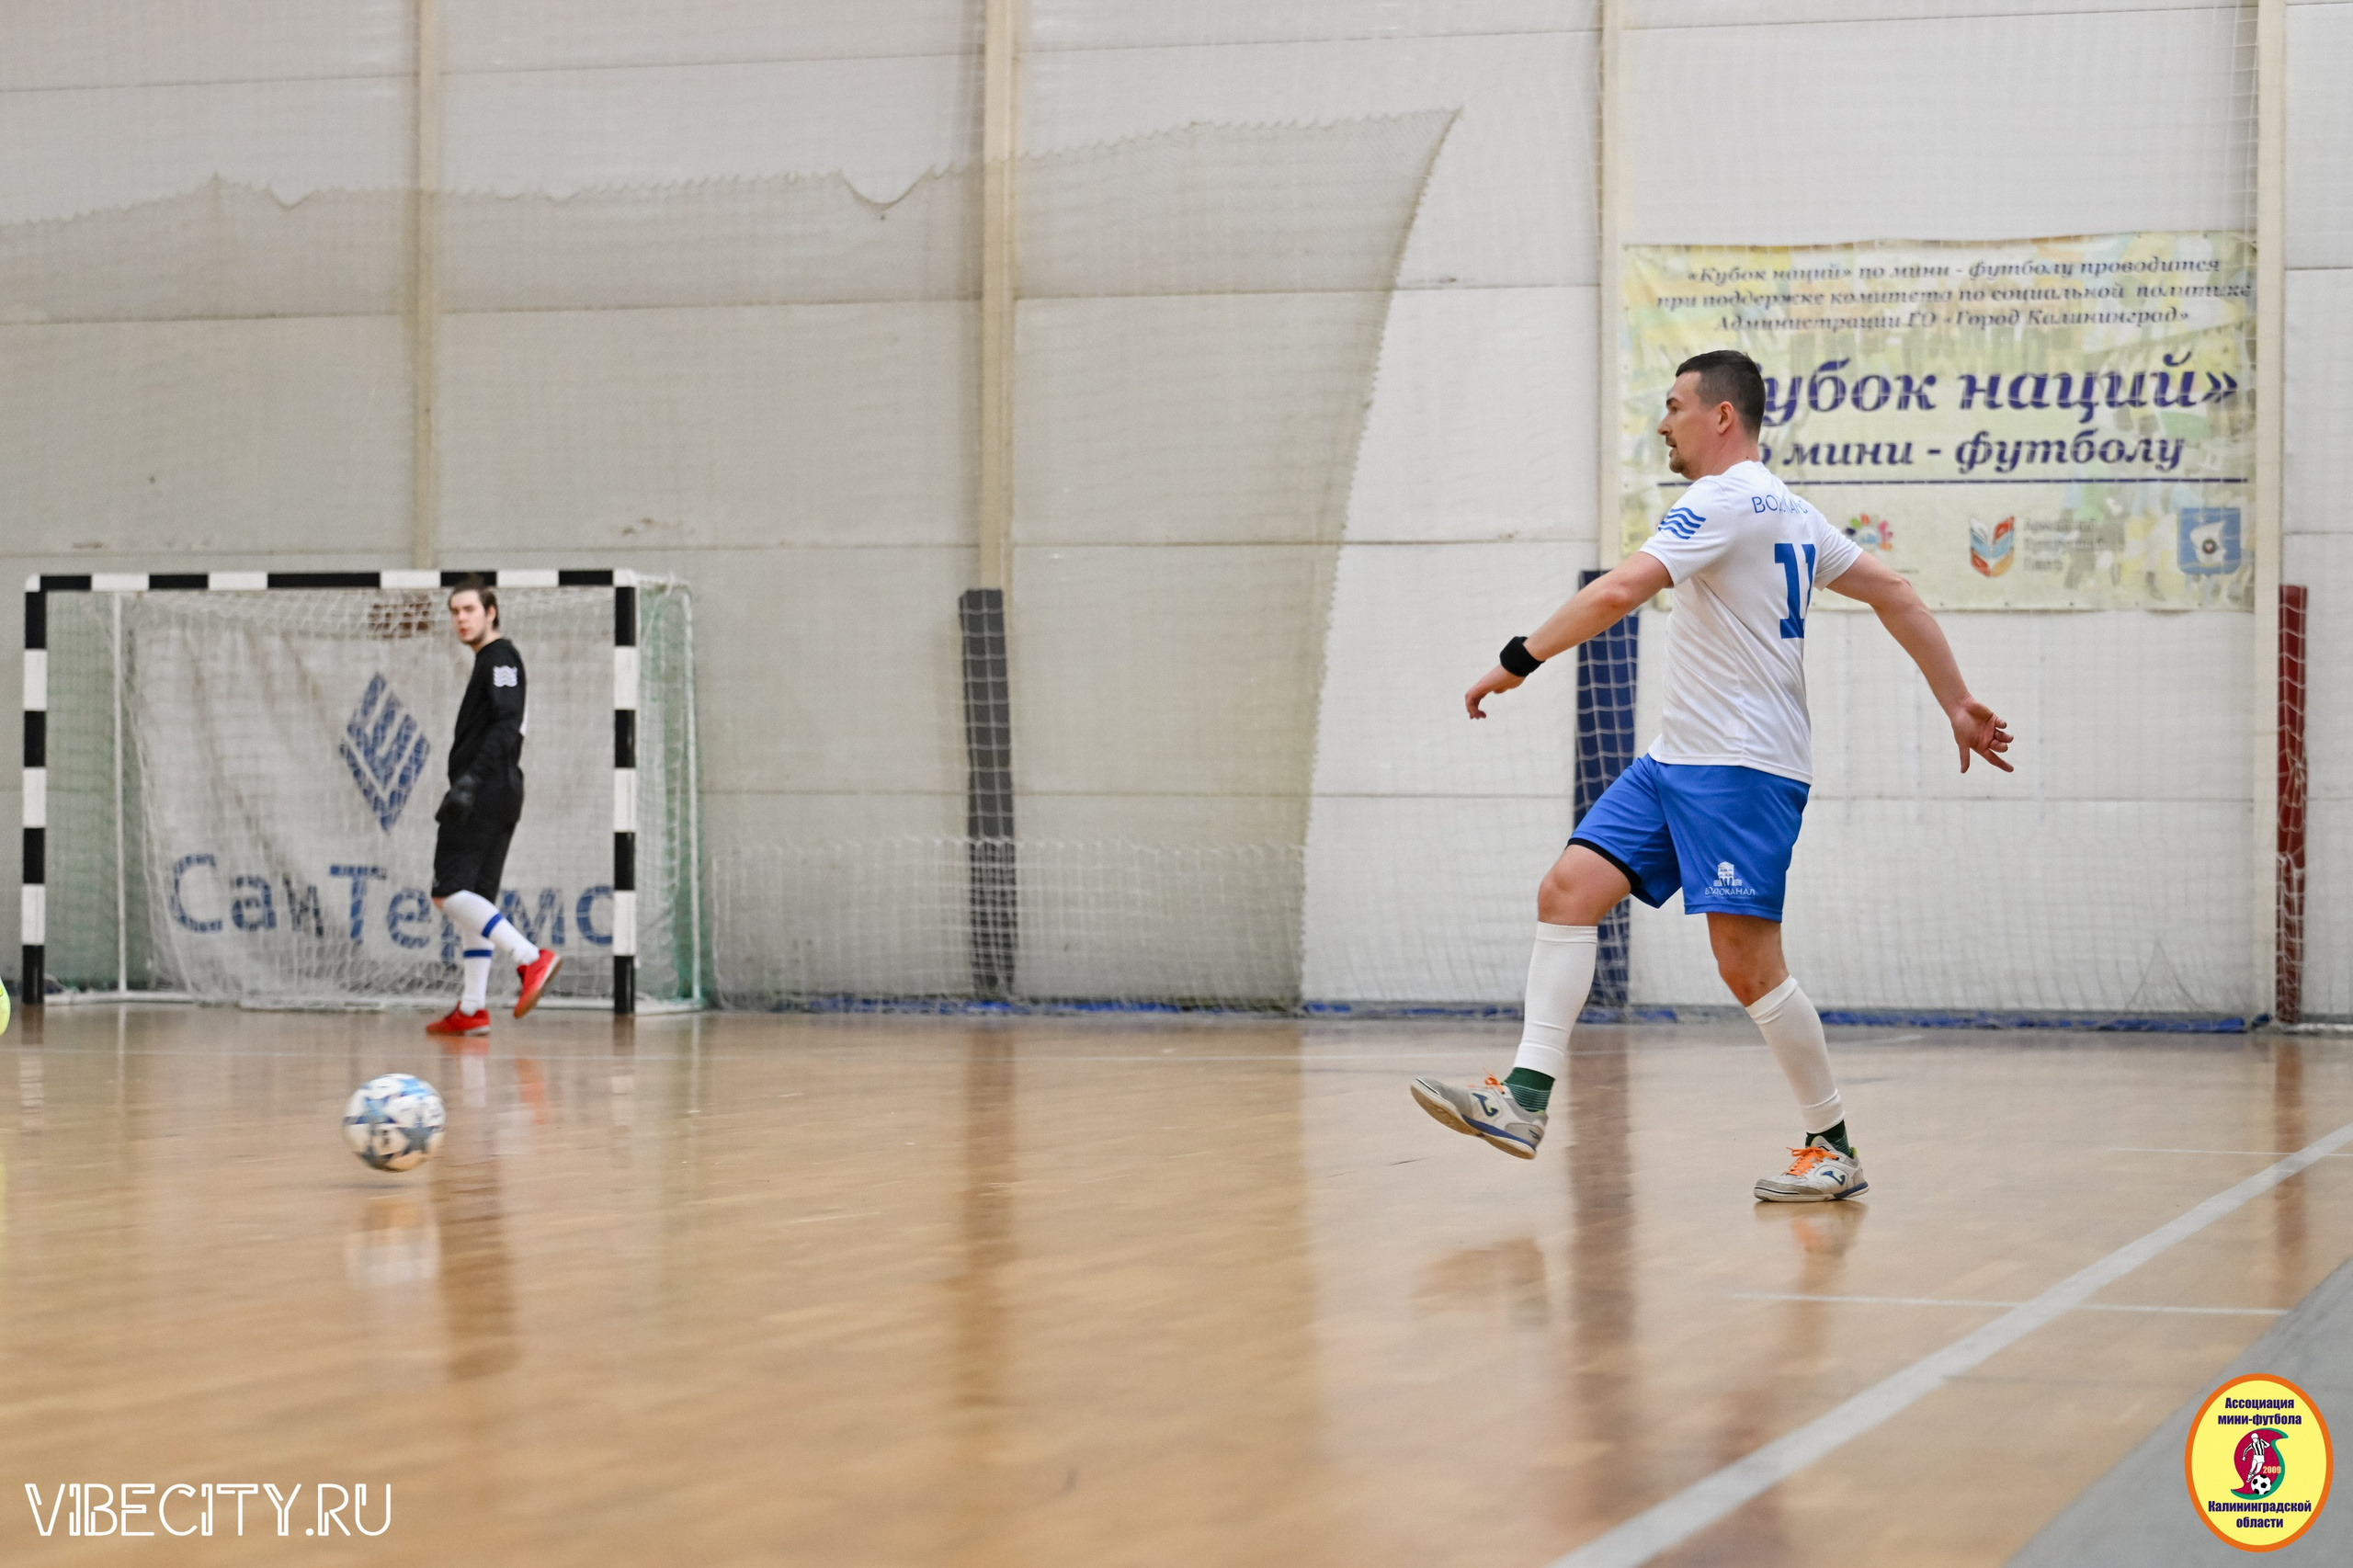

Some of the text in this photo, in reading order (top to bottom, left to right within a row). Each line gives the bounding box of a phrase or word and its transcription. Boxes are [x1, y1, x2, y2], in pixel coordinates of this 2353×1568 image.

[1687, 267, 1766, 286] «Кубок
[1772, 264, 1851, 281] наций»
[1858, 267, 1884, 279] по
[1891, 264, 1949, 277] мини
[1969, 260, 2073, 280] футболу
[2079, 256, 2220, 275] проводится
[1656, 282, 2252, 311] при поддержке комитета по социальной политике
[1717, 307, 2189, 333] Администрации ГО «Город Калининград»
[1756, 351, 2238, 427] убок наций»
[1782, 442, 1914, 466] мини
[1955, 428, 2187, 475] футболу
[1774, 543, 1816, 639] 11
